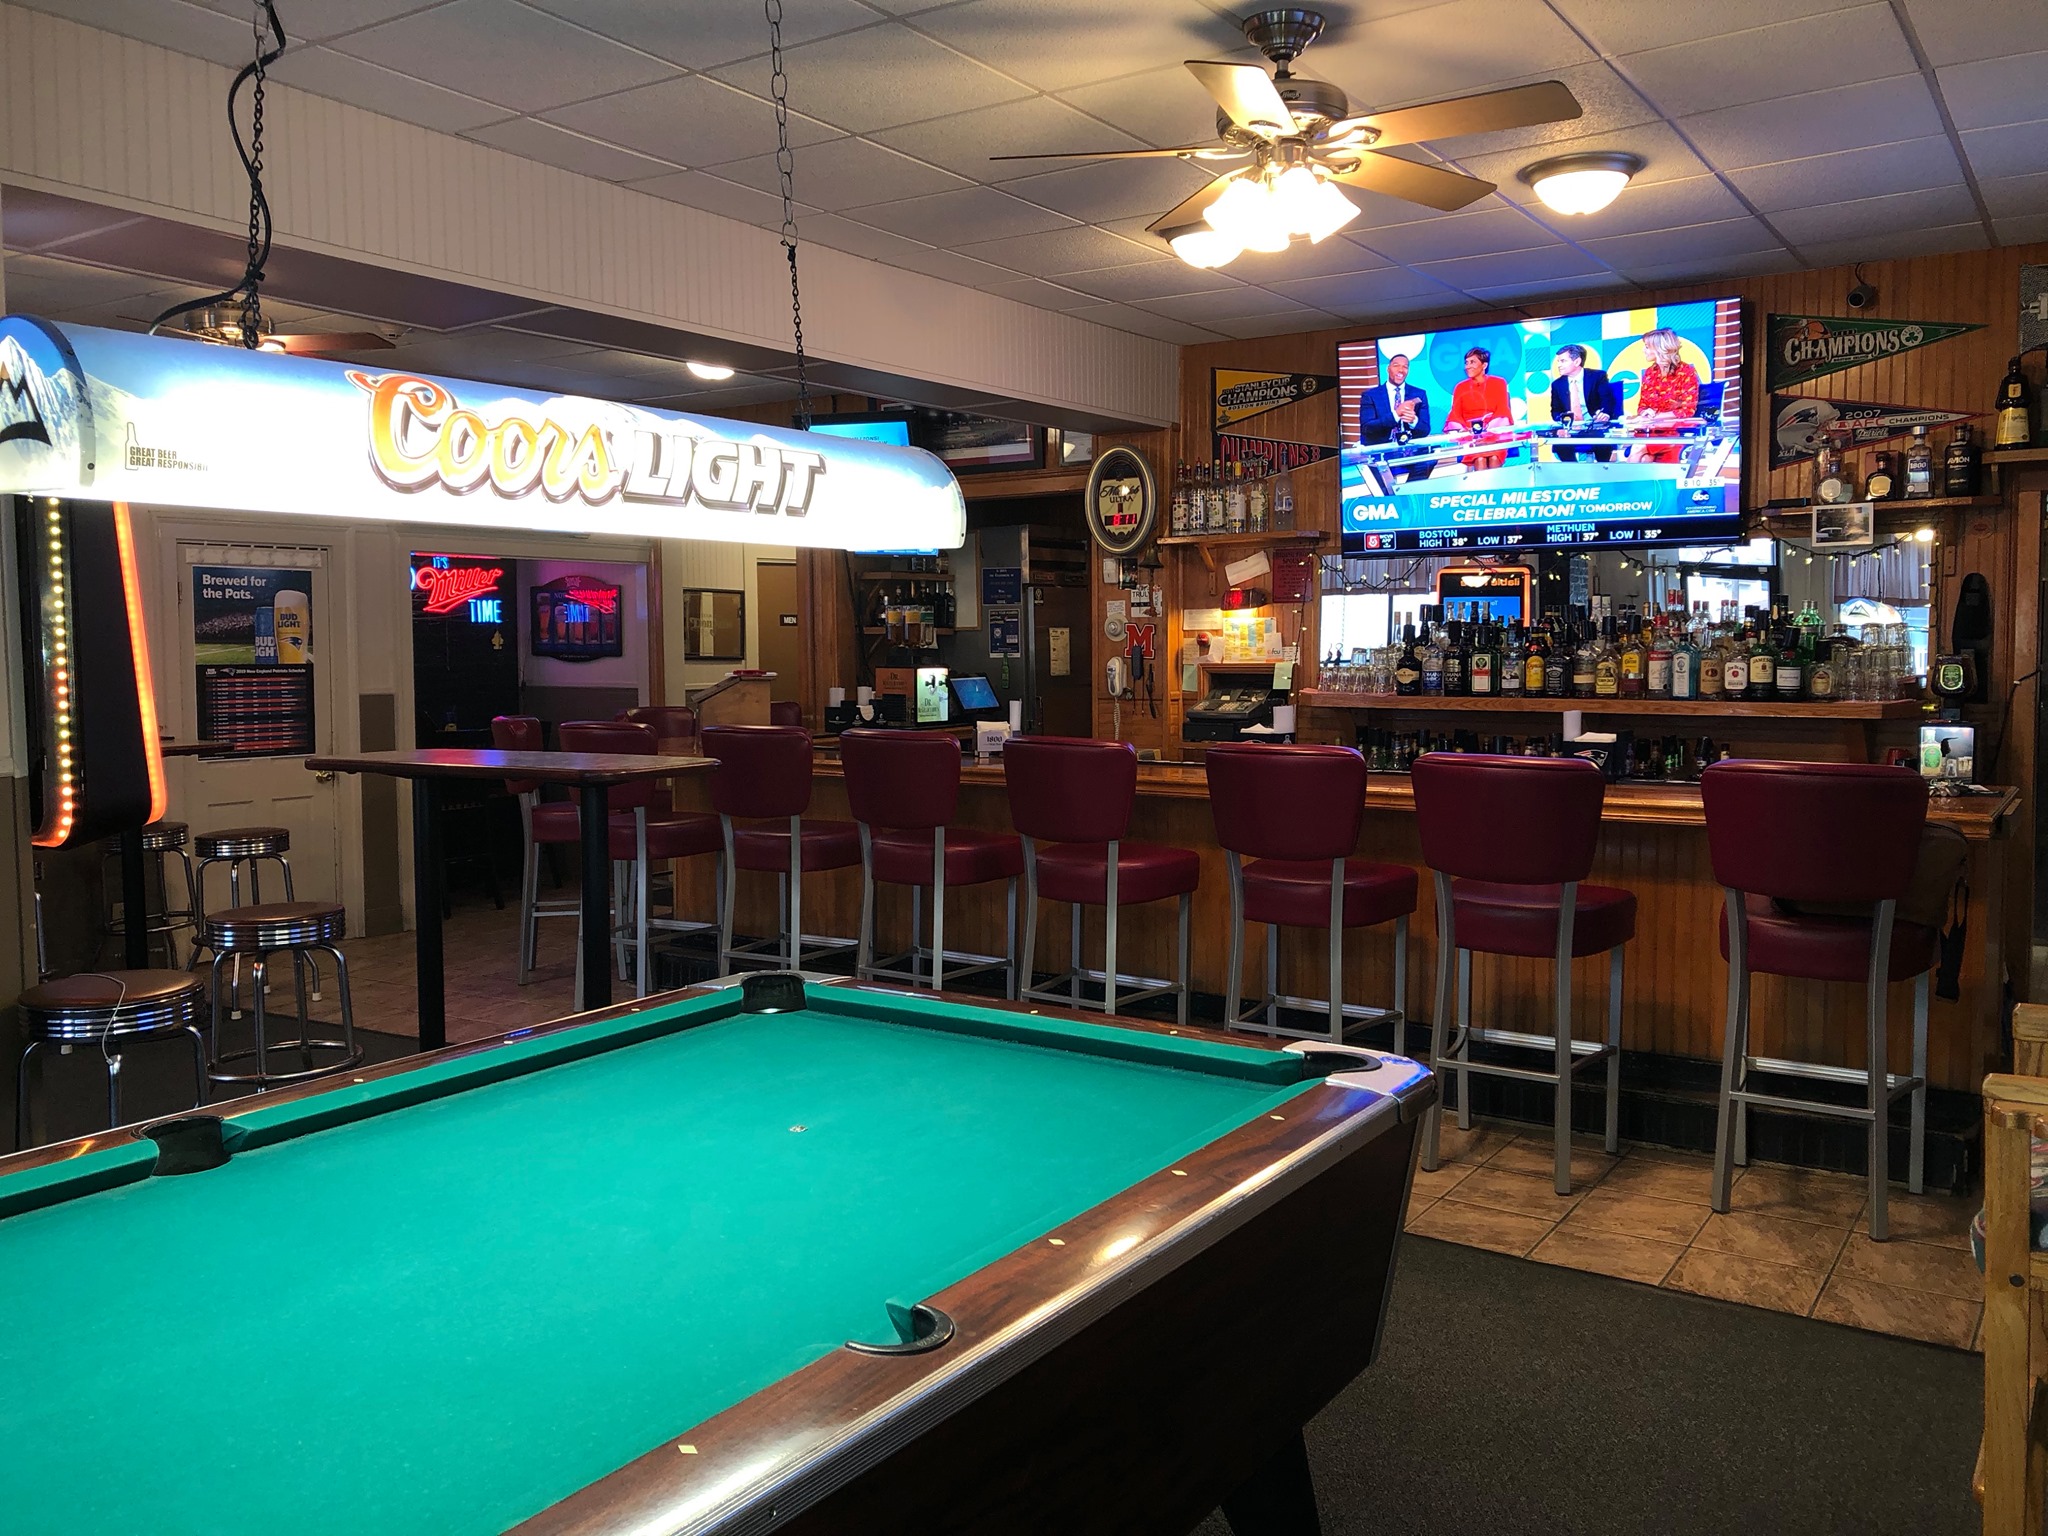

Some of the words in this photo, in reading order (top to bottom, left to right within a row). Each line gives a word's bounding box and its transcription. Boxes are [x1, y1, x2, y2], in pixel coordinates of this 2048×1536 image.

[1784, 330, 1900, 366] CHAMPIONS
[1234, 380, 1273, 393] STANLEY
[1272, 377, 1291, 387] CUP
[1219, 384, 1298, 406] CHAMPIONS
[1228, 403, 1254, 411] BOSTON
[1256, 400, 1280, 408] BRUINS
[1845, 410, 1881, 419] 2007
[1852, 418, 1886, 428] AFC
[1889, 414, 1949, 424] CHAMPIONS
[345, 370, 624, 507] Coors
[622, 429, 827, 517] LIGHT
[130, 446, 155, 457] GREAT
[158, 449, 177, 459] BEER
[130, 456, 155, 467] GREAT
[1430, 493, 1496, 509] SPECIAL
[1501, 487, 1601, 505] MILESTONE
[1353, 503, 1400, 521] GMA
[1453, 503, 1575, 522] CELEBRATION!
[1579, 501, 1653, 513] TOMORROW
[1419, 530, 1457, 538] BOSTON
[1547, 523, 1595, 533] METHUEN
[1419, 539, 1442, 548] HIGH
[1452, 538, 1468, 546] 38°
[1477, 537, 1500, 545] LOW
[1507, 535, 1523, 544] 37°
[1547, 533, 1572, 542] HIGH
[1582, 532, 1599, 541] 37°
[1609, 531, 1634, 540] LOW
[1644, 529, 1662, 539] 35°
[202, 574, 247, 586] Brewed
[250, 576, 267, 587] for
[416, 566, 503, 605] Miller
[203, 588, 223, 599] the
[225, 588, 254, 599] Pats.
[280, 613, 298, 621] BUD
[468, 599, 503, 624] TIME
[783, 616, 797, 624] MEN
[255, 636, 276, 647] BUD
[1124, 624, 1155, 659] M
[986, 735, 1003, 743] 1800
